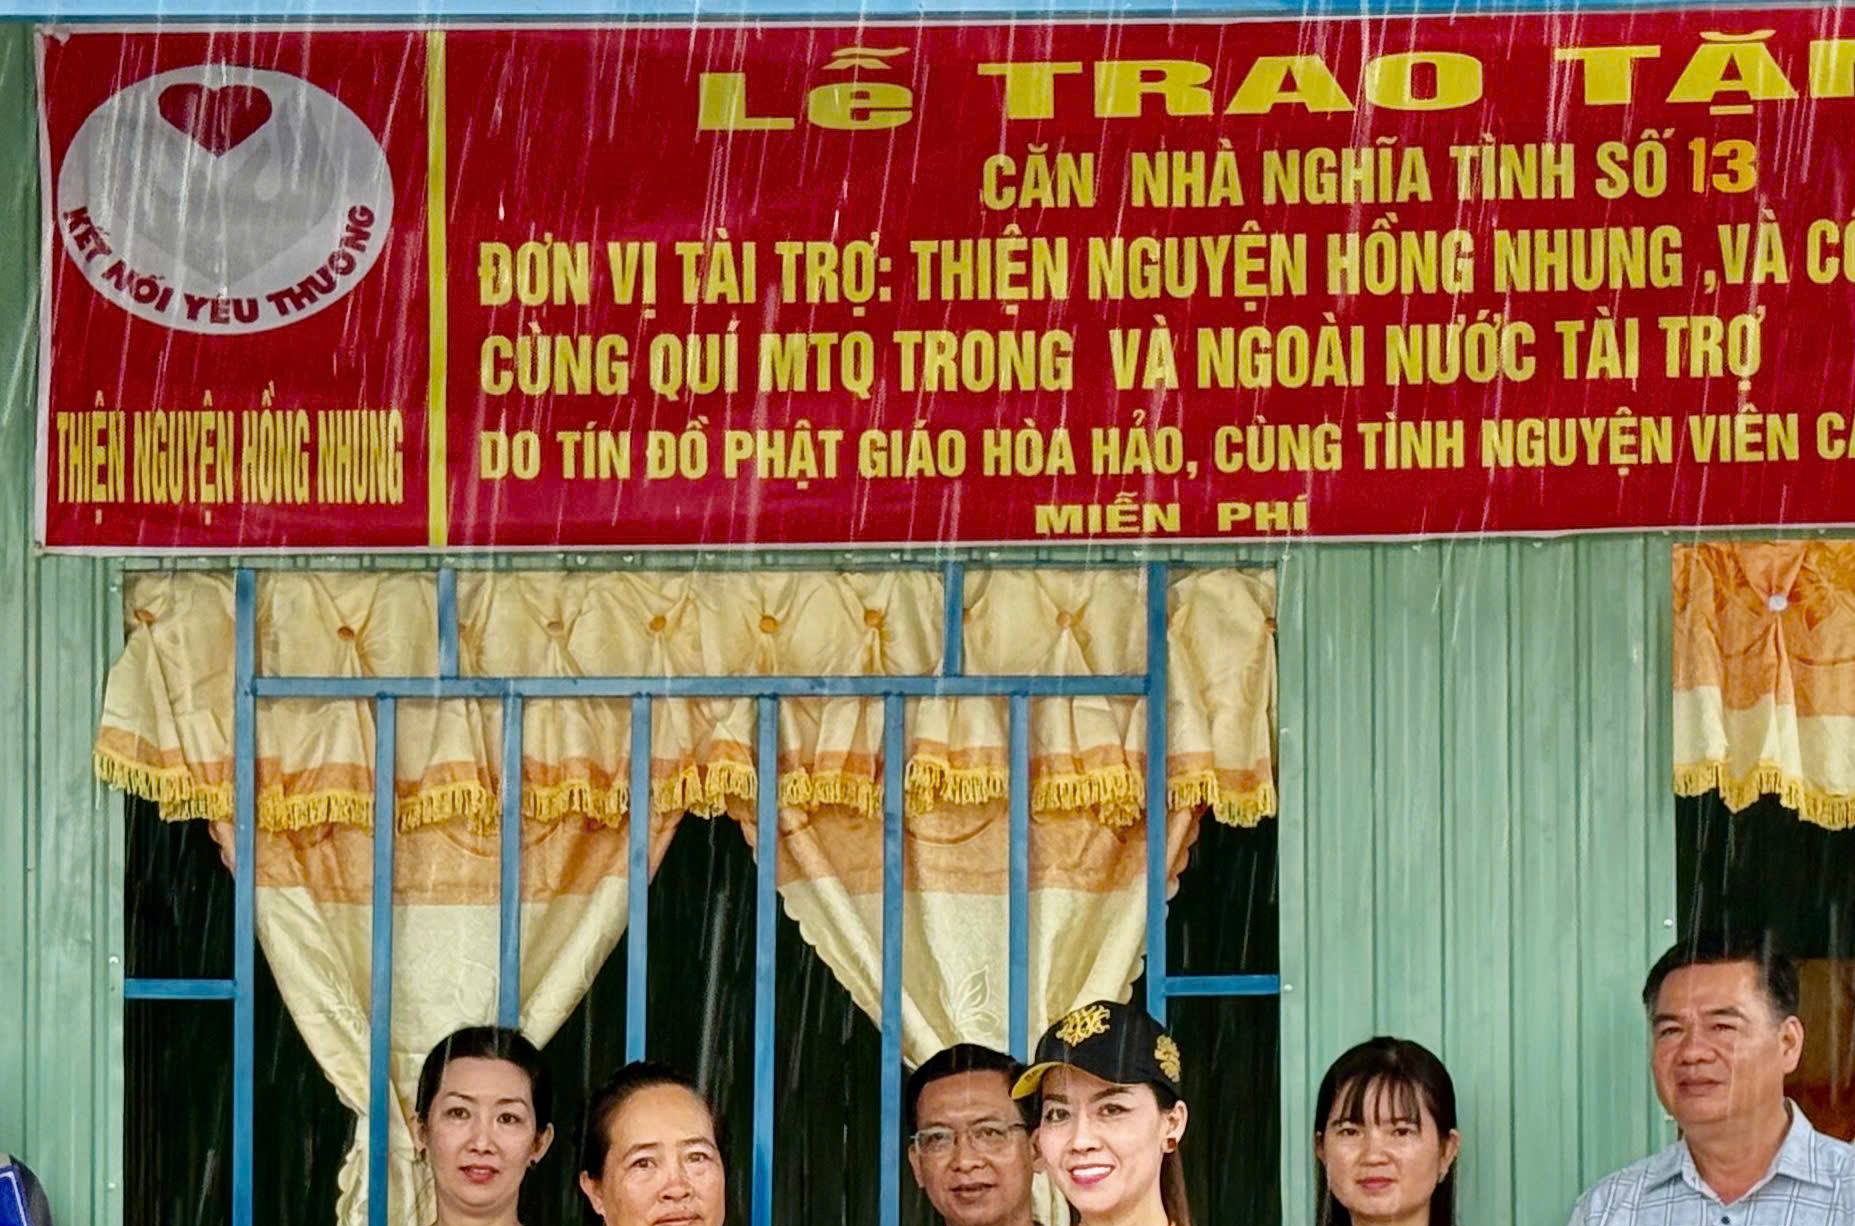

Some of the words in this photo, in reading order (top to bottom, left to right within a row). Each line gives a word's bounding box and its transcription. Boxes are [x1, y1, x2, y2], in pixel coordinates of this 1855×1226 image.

[698, 46, 914, 132] Lễ
[976, 50, 1484, 121] TRAO
[982, 142, 1097, 211] CĂN
[1130, 137, 1245, 209] NHÀ
[1262, 135, 1433, 206] NGHĨA
[1448, 132, 1576, 202] TÌNH
[1594, 127, 1676, 200] SỐ
[1688, 137, 1759, 195] 13
[477, 231, 592, 308] ĐƠN
[606, 240, 658, 320] VỊ
[674, 227, 758, 306] TÀI
[774, 231, 892, 319] TRỢ:
[910, 224, 1069, 316] THIỆN
[1087, 220, 1308, 313] NGUYỆN
[1326, 212, 1476, 297] HỒNG
[1492, 224, 1684, 295] NHUNG
[479, 321, 630, 397] CÙNG
[648, 319, 741, 402] QUÍ
[757, 330, 875, 401] MTQ
[892, 328, 1076, 394] TRONG
[1107, 314, 1181, 391] VÀ
[1196, 312, 1366, 390] NGOÀI
[1384, 308, 1538, 386] NƯỚC
[1553, 305, 1640, 381] TÀI
[1656, 304, 1768, 394] TRỢ
[56, 389, 127, 526] THIỆN
[132, 389, 236, 526] NGUYỆN
[316, 408, 405, 506] NHUNG
[478, 429, 543, 482] DO
[555, 419, 632, 481] TÍN
[645, 415, 710, 481] ĐỒ
[723, 418, 846, 490] PHẬT
[857, 418, 967, 479] GIÁO
[982, 417, 1077, 478] HÒA
[1091, 409, 1199, 480] HẢO,
[1213, 414, 1343, 474] CÙNG
[1357, 412, 1466, 472] TÌNH
[1480, 405, 1675, 477] NGUYỆN
[1688, 404, 1801, 464] VIÊN
[1815, 411, 1855, 462] C
[1033, 491, 1183, 535] MIỄN
[1216, 494, 1310, 533] PHÍ
